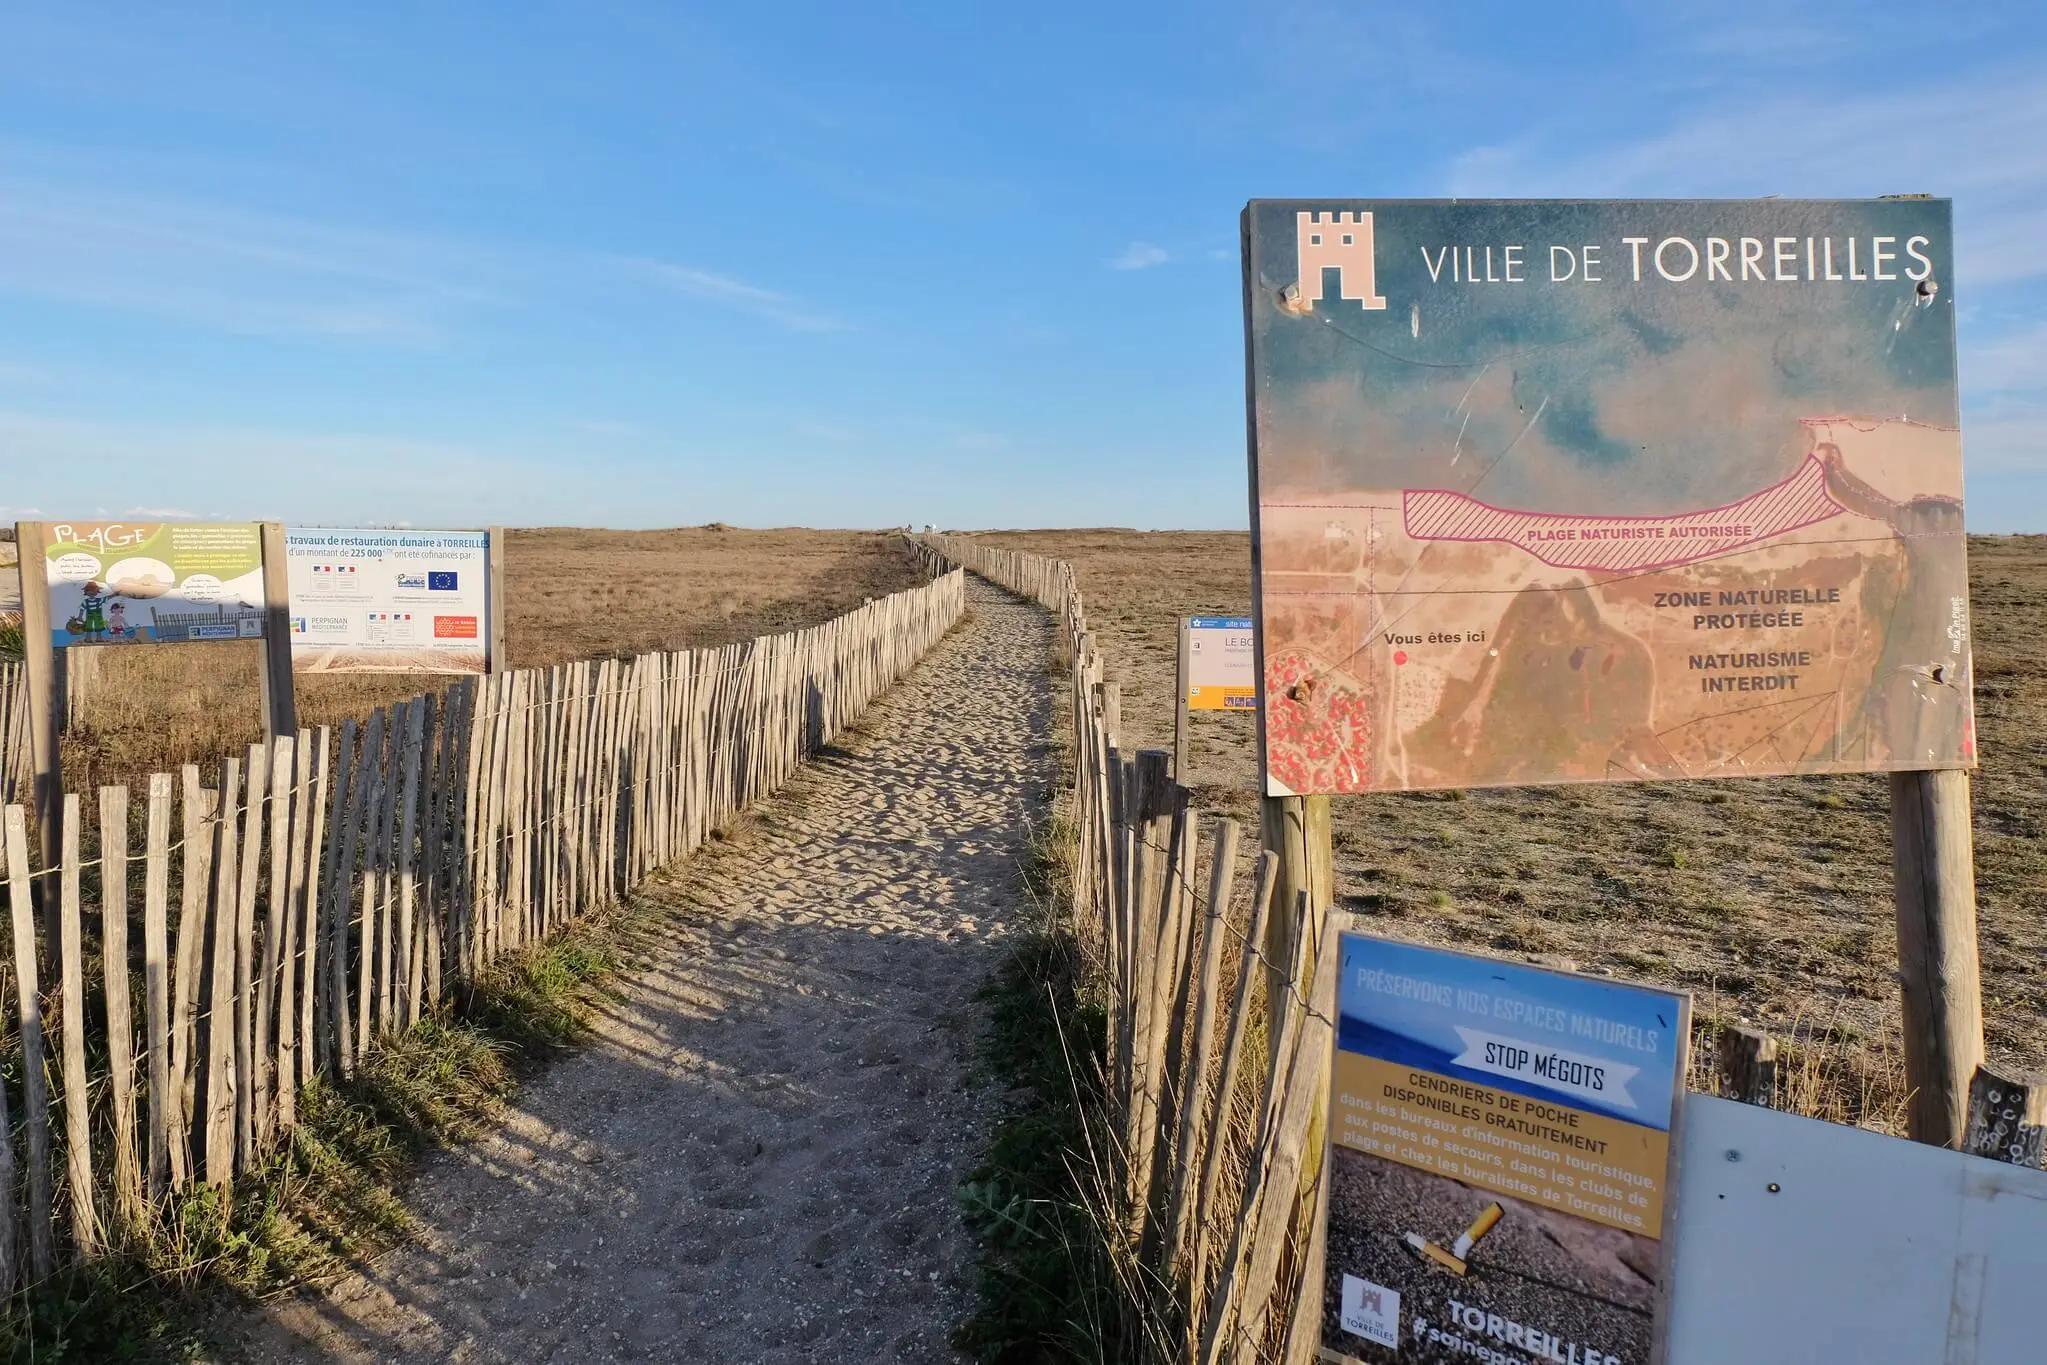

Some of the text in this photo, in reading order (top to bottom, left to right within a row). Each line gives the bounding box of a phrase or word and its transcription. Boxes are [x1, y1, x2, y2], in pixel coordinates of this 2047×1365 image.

[1421, 235, 1932, 283] VILLE DE TORREILLES
[53, 524, 145, 554] PLAGE
[290, 535, 326, 545] travaux
[328, 535, 340, 546] de
[341, 536, 397, 547] restauration
[400, 537, 435, 548] dunaire
[436, 538, 442, 548] à
[443, 539, 490, 549] TORREILLES
[1527, 524, 1752, 541] PLAGE NATURISTE AUTORISÉE
[289, 547, 305, 557] d'un
[307, 548, 338, 557] montant
[340, 548, 350, 558] de
[351, 549, 366, 558] 225
[367, 549, 382, 558] 000
[394, 550, 407, 559] ont
[459, 551, 472, 561] par
[1654, 588, 1840, 607] ZONE NATURELLE
[311, 617, 348, 625] PERPIGNAN
[1693, 609, 1803, 630] PROTÉGÉE
[1225, 637, 1238, 647] LE
[1384, 630, 1486, 645] Vous êtes ici
[1688, 651, 1810, 670] NATURISME
[1701, 675, 1799, 693] INTERDIT
[1357, 967, 1659, 1053] PRÉSERVONS NOS ESPACES NATURELS
[1485, 1042, 1605, 1091] STOP MÉGOTS
[1408, 1073, 1580, 1128] CENDRIERS DE POCHE
[1340, 1091, 1373, 1112] dans
[1376, 1100, 1397, 1117] les
[1400, 1107, 1457, 1134] bureaux
[1462, 1125, 1561, 1164] d'information
[1383, 1084, 1608, 1155] DISPONIBLES GRATUITEMENT
[1344, 1113, 1649, 1208] aux postes de secours, dans les clubs de
[1343, 1131, 1646, 1229] plage et chez les buralistes de Torreilles.
[1345, 1316, 1395, 1342] TORREILLES
